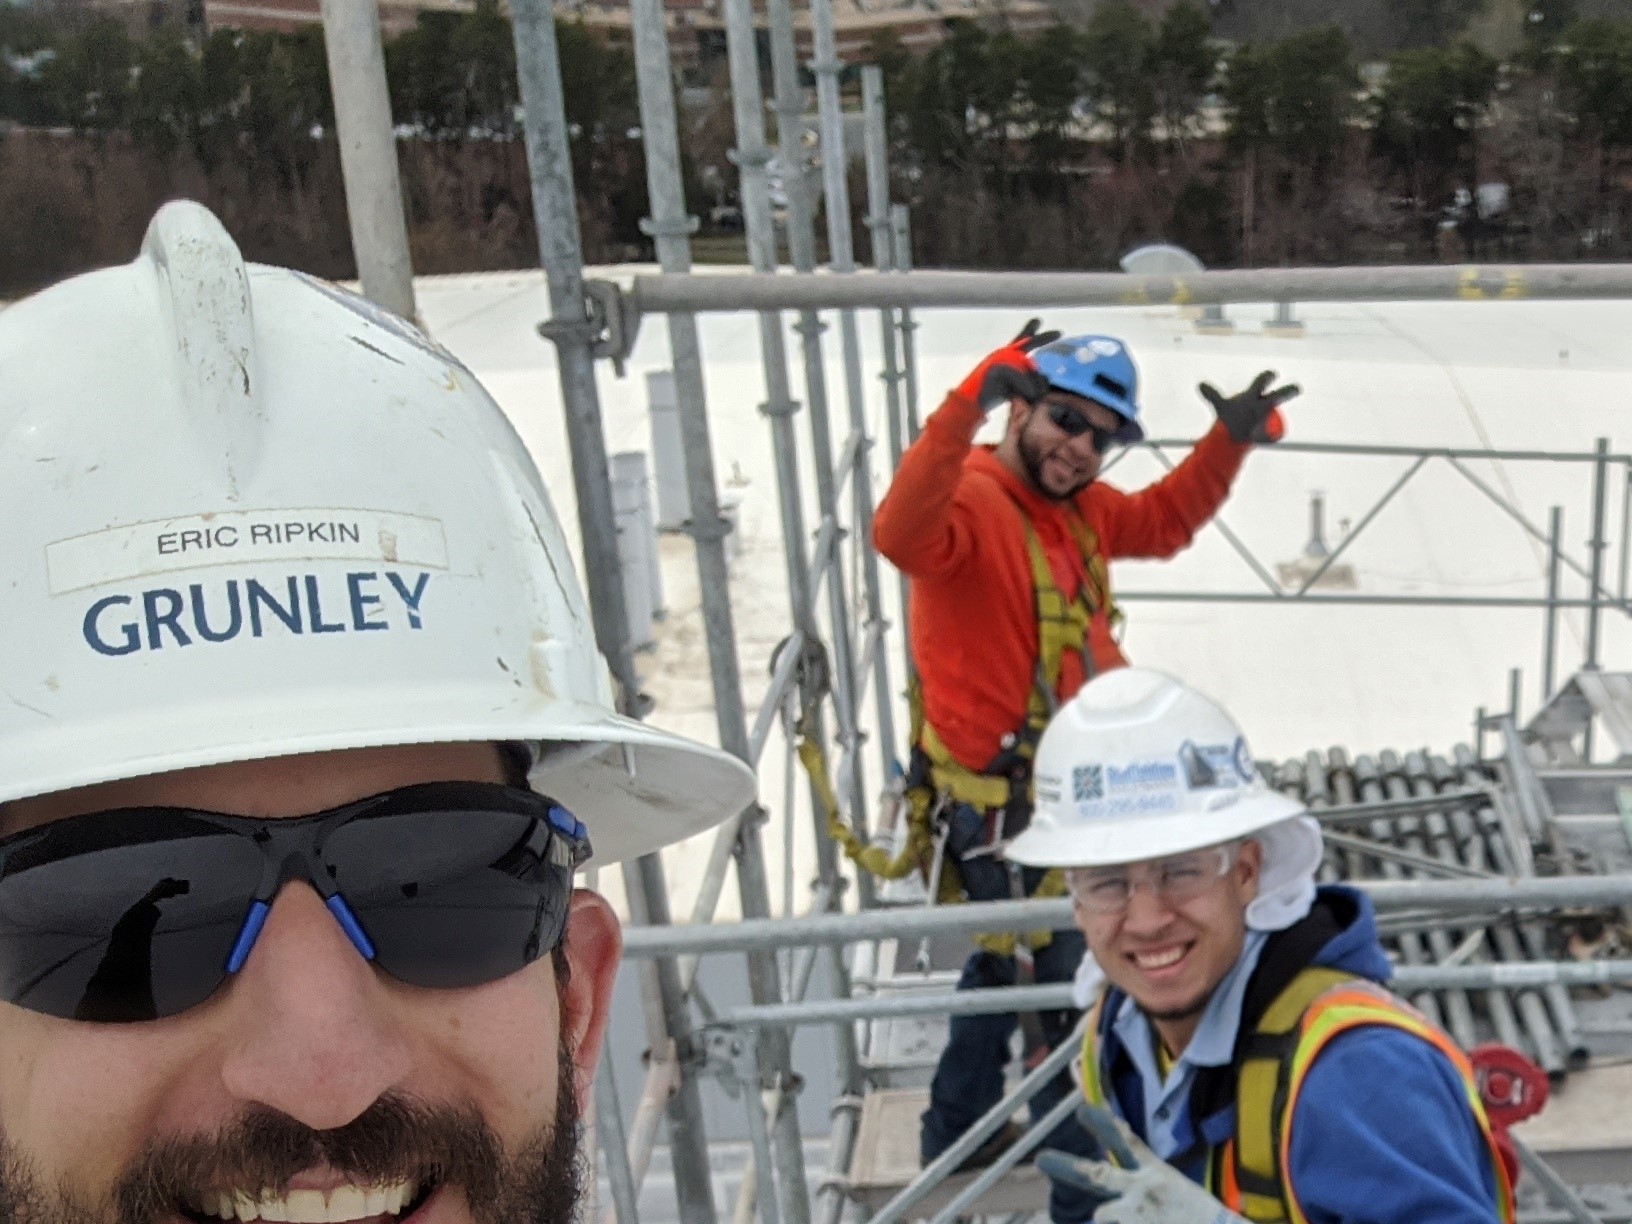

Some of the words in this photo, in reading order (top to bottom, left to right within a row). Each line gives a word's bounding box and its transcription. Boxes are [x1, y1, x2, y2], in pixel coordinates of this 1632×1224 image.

[157, 525, 239, 555] ERIC
[250, 521, 361, 546] RIPKIN
[82, 571, 431, 657] GRUNLEY
